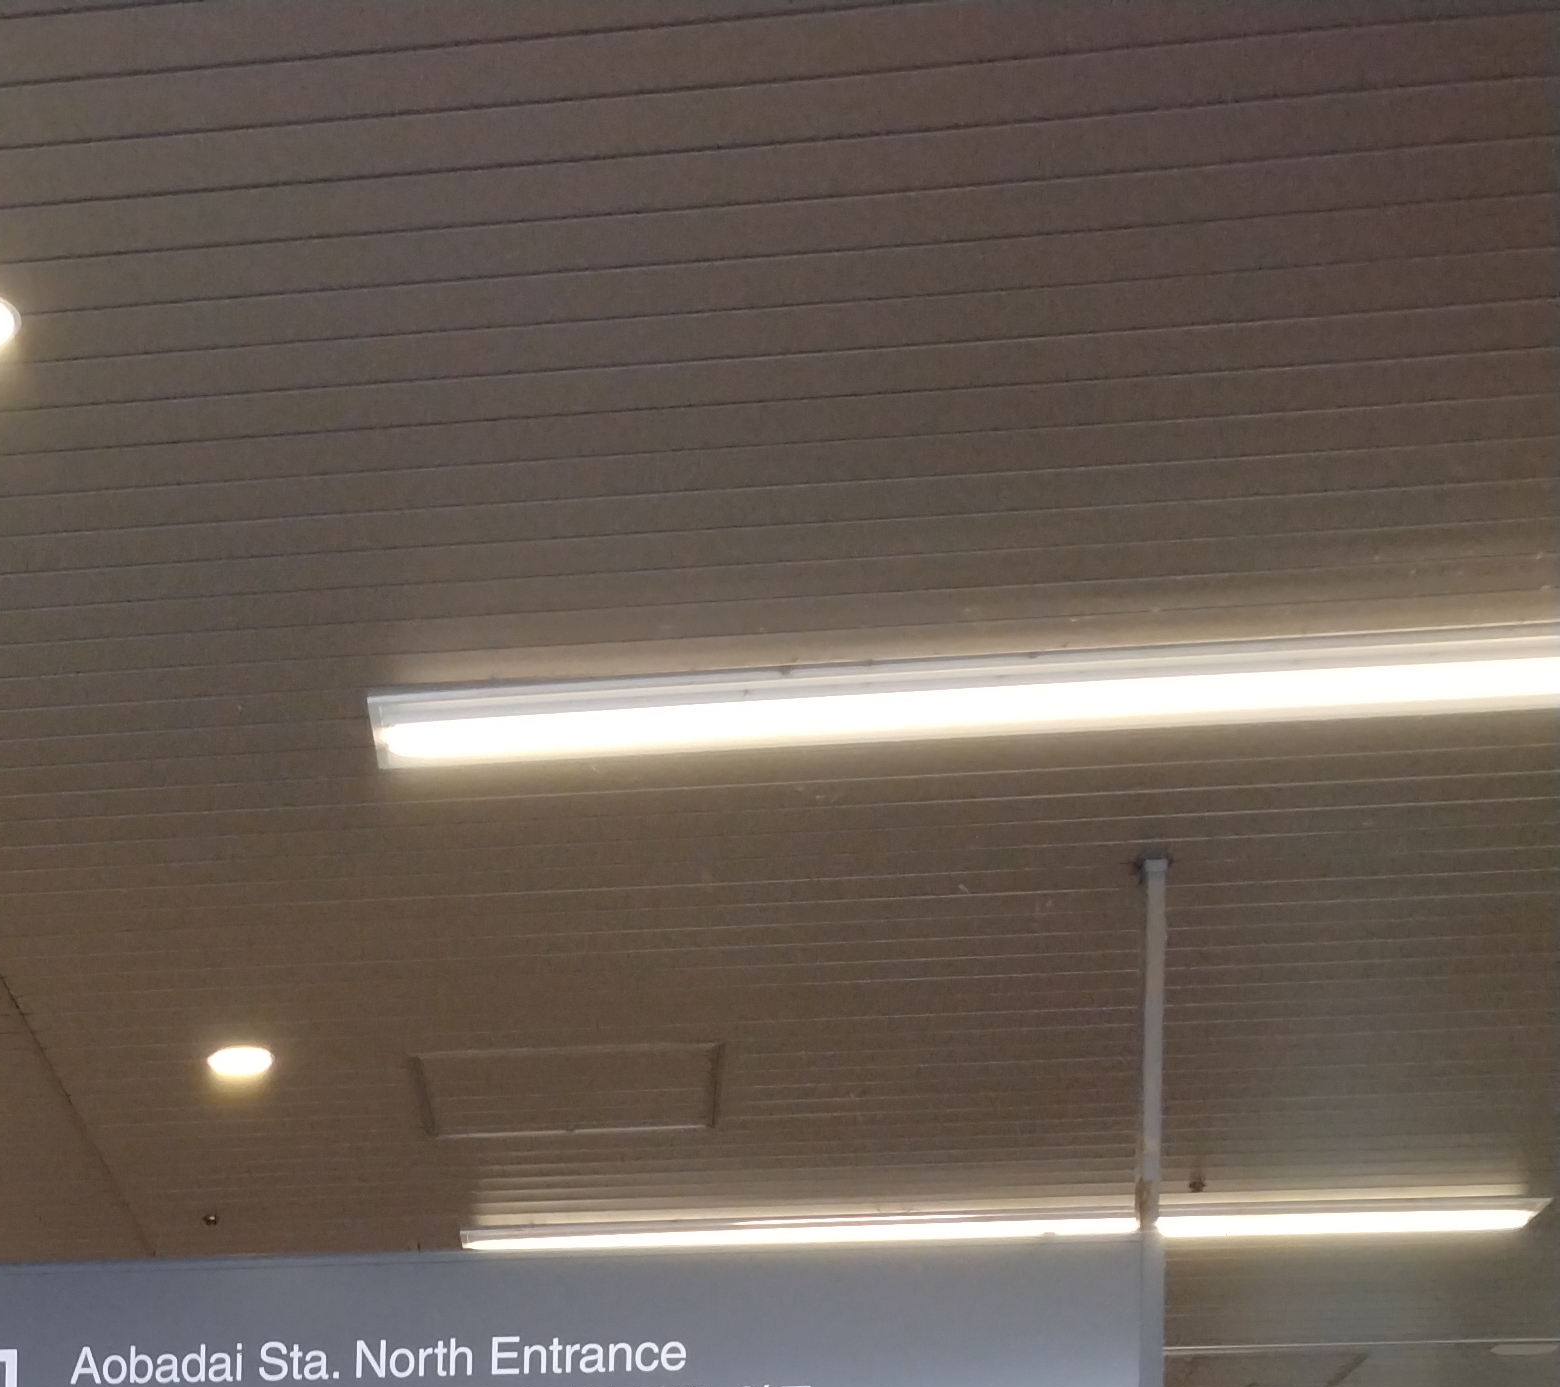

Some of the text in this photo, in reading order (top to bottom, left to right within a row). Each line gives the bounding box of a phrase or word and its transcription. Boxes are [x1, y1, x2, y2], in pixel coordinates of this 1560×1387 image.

[70, 1335, 687, 1385] Aobadai Sta. North Entrance
